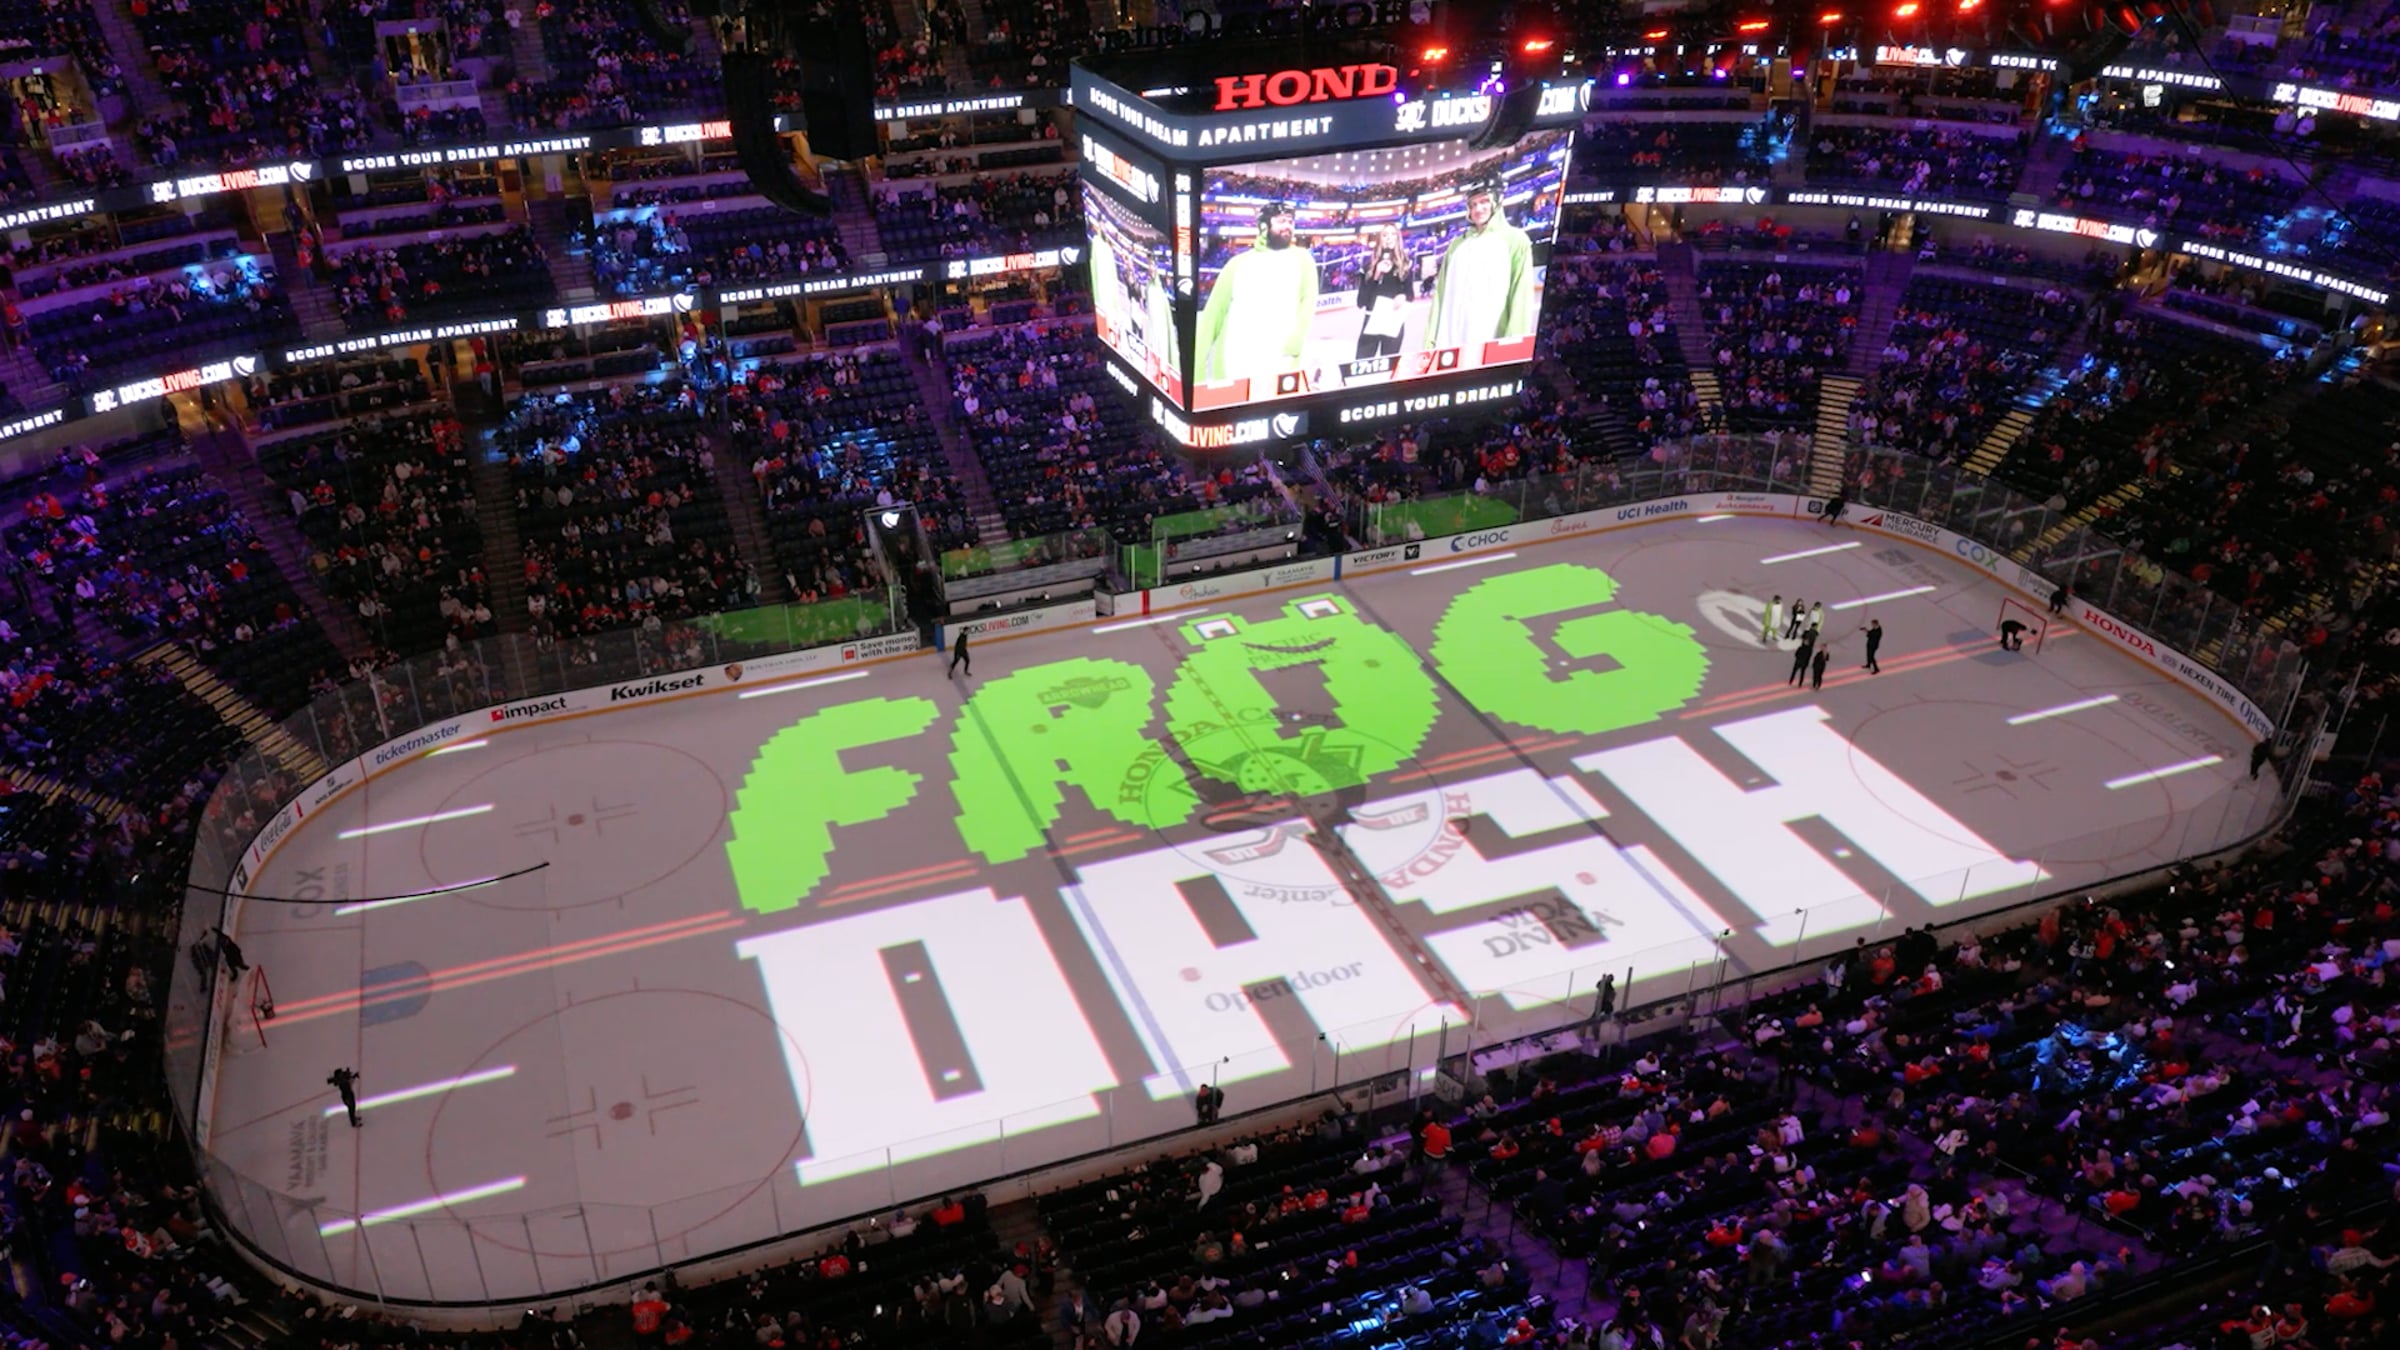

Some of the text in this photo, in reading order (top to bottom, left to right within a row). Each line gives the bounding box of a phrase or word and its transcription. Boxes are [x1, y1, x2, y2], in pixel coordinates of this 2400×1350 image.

[1991, 55, 2037, 69] SCORE
[1213, 62, 1398, 111] HOND
[2297, 86, 2400, 121] DUCKSLIVING.COM
[897, 99, 943, 118] DREAM
[947, 95, 1024, 113] APARTMENT
[1144, 116, 1189, 148] DREAM
[1198, 116, 1333, 147] APARTMENT
[342, 137, 592, 172] SCORE YOUR DREAM APARTMENT
[178, 165, 290, 197] DUCKSLIVING.COM
[1563, 191, 1615, 204] ARTMENT
[1788, 192, 1990, 218] SCORE YOUR DREAM APARTMENT
[2036, 212, 2136, 244] DUCKSLIVING.COM
[720, 268, 924, 303] SCORE YOUR DREAM APARTMENT
[2181, 241, 2390, 303] SCORE YOUR DREAM APARTMENT
[570, 296, 672, 325] DUCKSLIVING.COM
[286, 344, 335, 363] SCORE
[337, 337, 377, 354] YOUR
[436, 318, 519, 338] APARTMENT
[118, 361, 233, 405] DUCKSLIVING.COM
[1340, 383, 1514, 423] SCORE YOUR DREAM
[1616, 499, 1688, 521] UCI Health
[1885, 513, 1940, 536] MERCURY
[1467, 530, 1510, 548] CHOC
[1883, 521, 1938, 545] INSURANCE
[1955, 538, 2001, 573] COX
[958, 615, 1030, 635] DCKSLIVING.COM
[2083, 608, 2157, 658] HONDA
[859, 641, 884, 650] Save
[860, 647, 882, 658] with
[884, 645, 901, 655] the
[610, 673, 705, 702] Kwikset
[2178, 663, 2236, 707] NEXEN TIRE
[503, 696, 567, 719] impact
[375, 724, 461, 765] ticketmaster
[726, 564, 1709, 914] FROG
[1118, 715, 1222, 806] HONDA
[1381, 791, 1472, 891] HONDA
[1488, 893, 1585, 929] VIDA
[737, 705, 2050, 1186] DASH
[1481, 907, 1626, 958] DIVINA
[1203, 959, 1364, 1015] Opendoor
